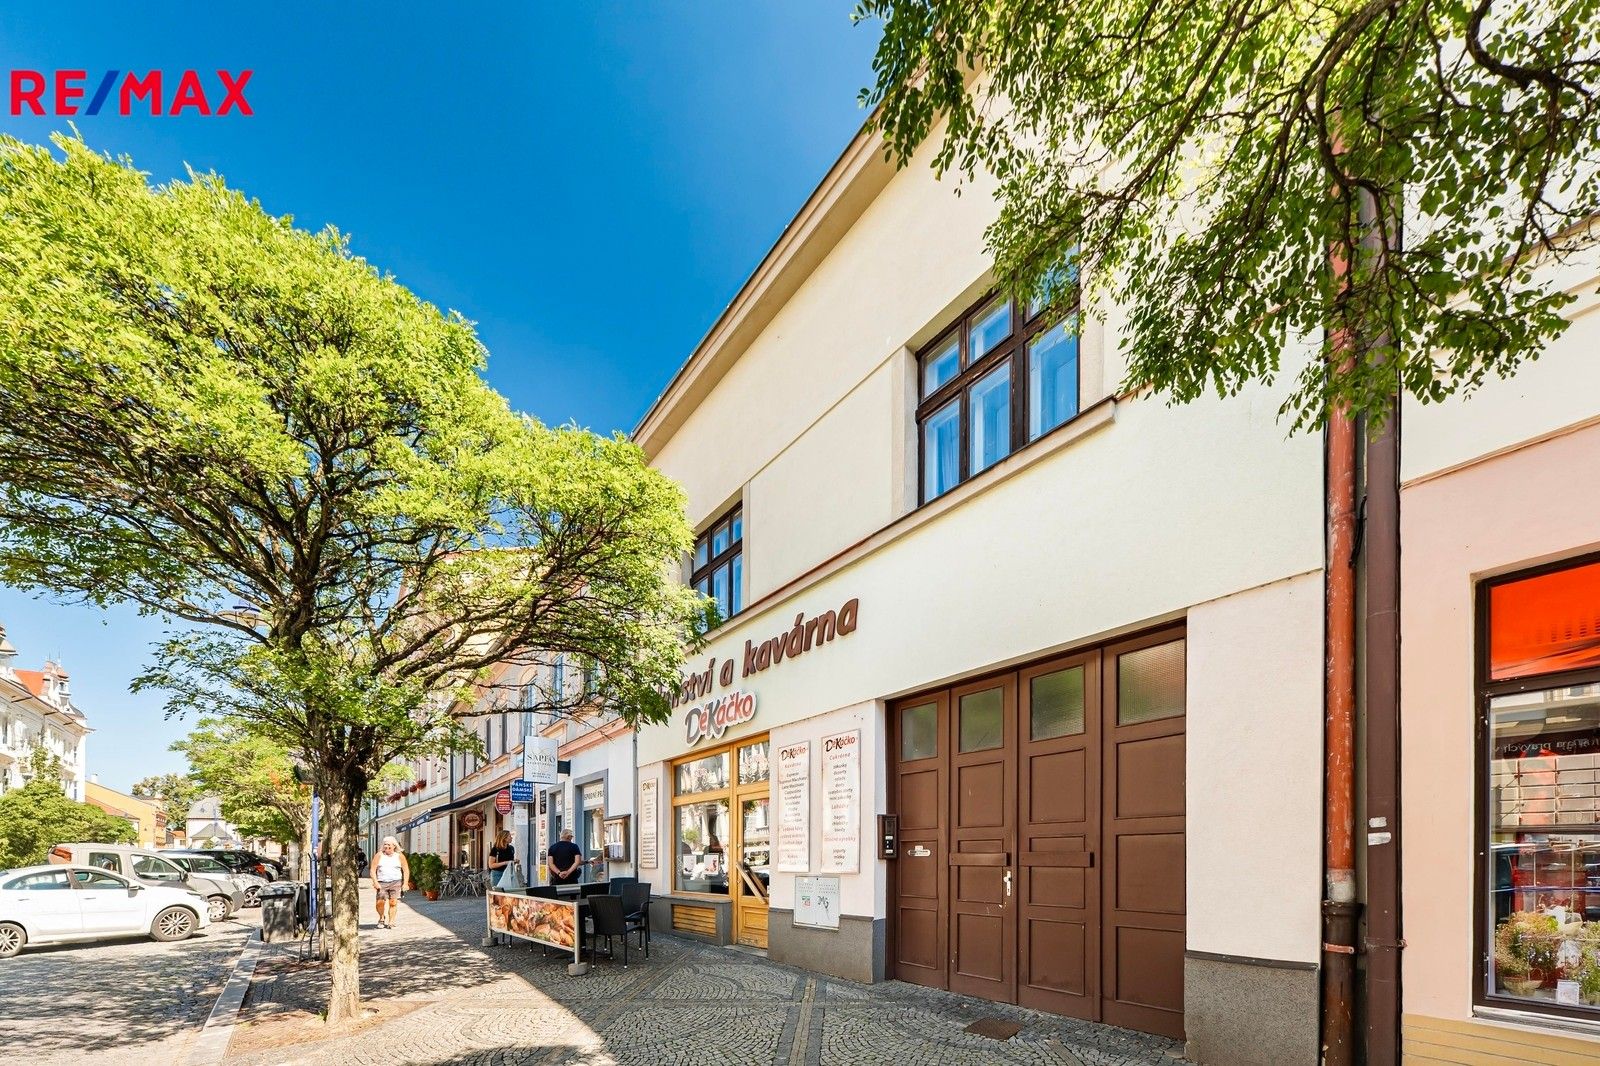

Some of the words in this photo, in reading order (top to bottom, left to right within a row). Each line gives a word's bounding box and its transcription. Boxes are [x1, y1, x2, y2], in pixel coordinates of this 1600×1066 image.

[719, 658, 734, 687] a
[742, 598, 859, 678] kavárna
[685, 691, 754, 744] DéKáčko
